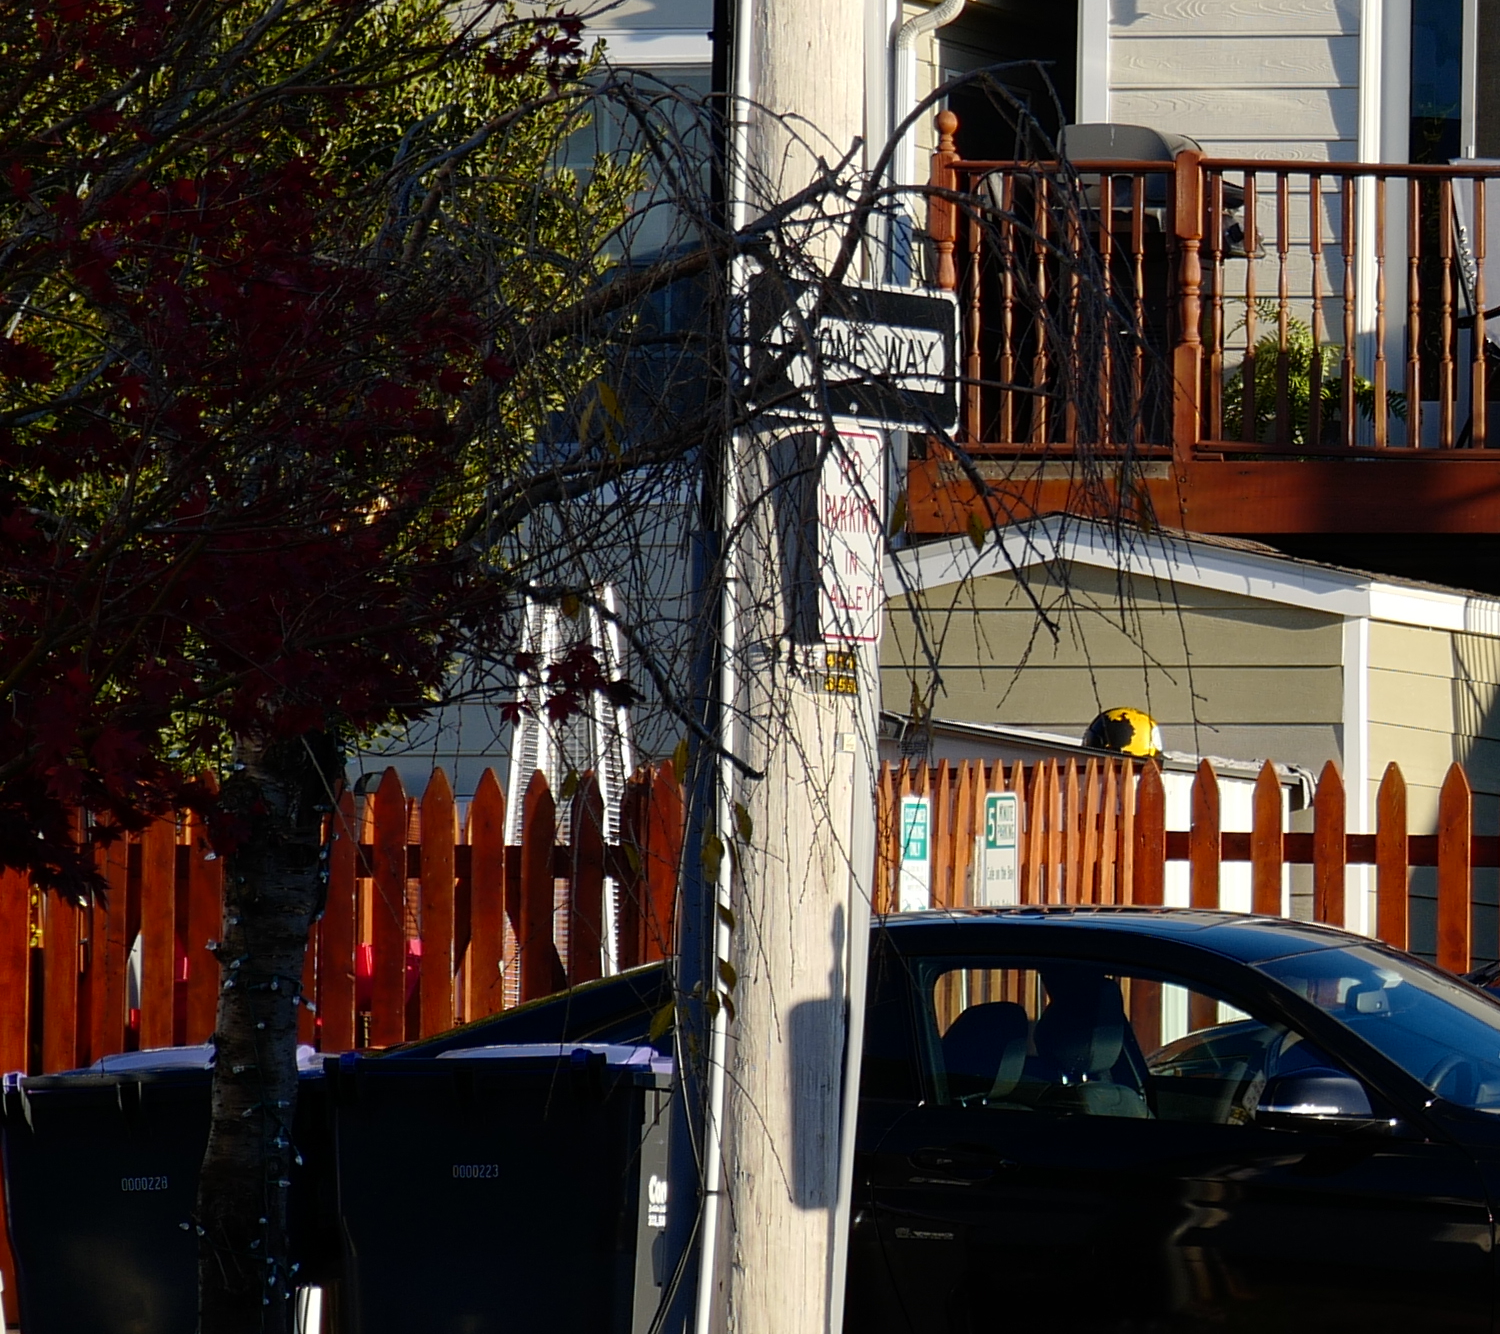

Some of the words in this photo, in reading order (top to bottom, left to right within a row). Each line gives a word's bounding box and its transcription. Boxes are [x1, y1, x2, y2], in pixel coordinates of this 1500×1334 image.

[818, 326, 865, 371] ONE
[884, 334, 935, 381] WAY
[840, 450, 863, 485] NO
[825, 494, 877, 535] PARKING
[845, 550, 858, 575] IN
[831, 583, 872, 612] ALLEY
[988, 807, 995, 841] 5
[121, 1176, 168, 1192] 0000228
[452, 1164, 499, 1179] 0000223
